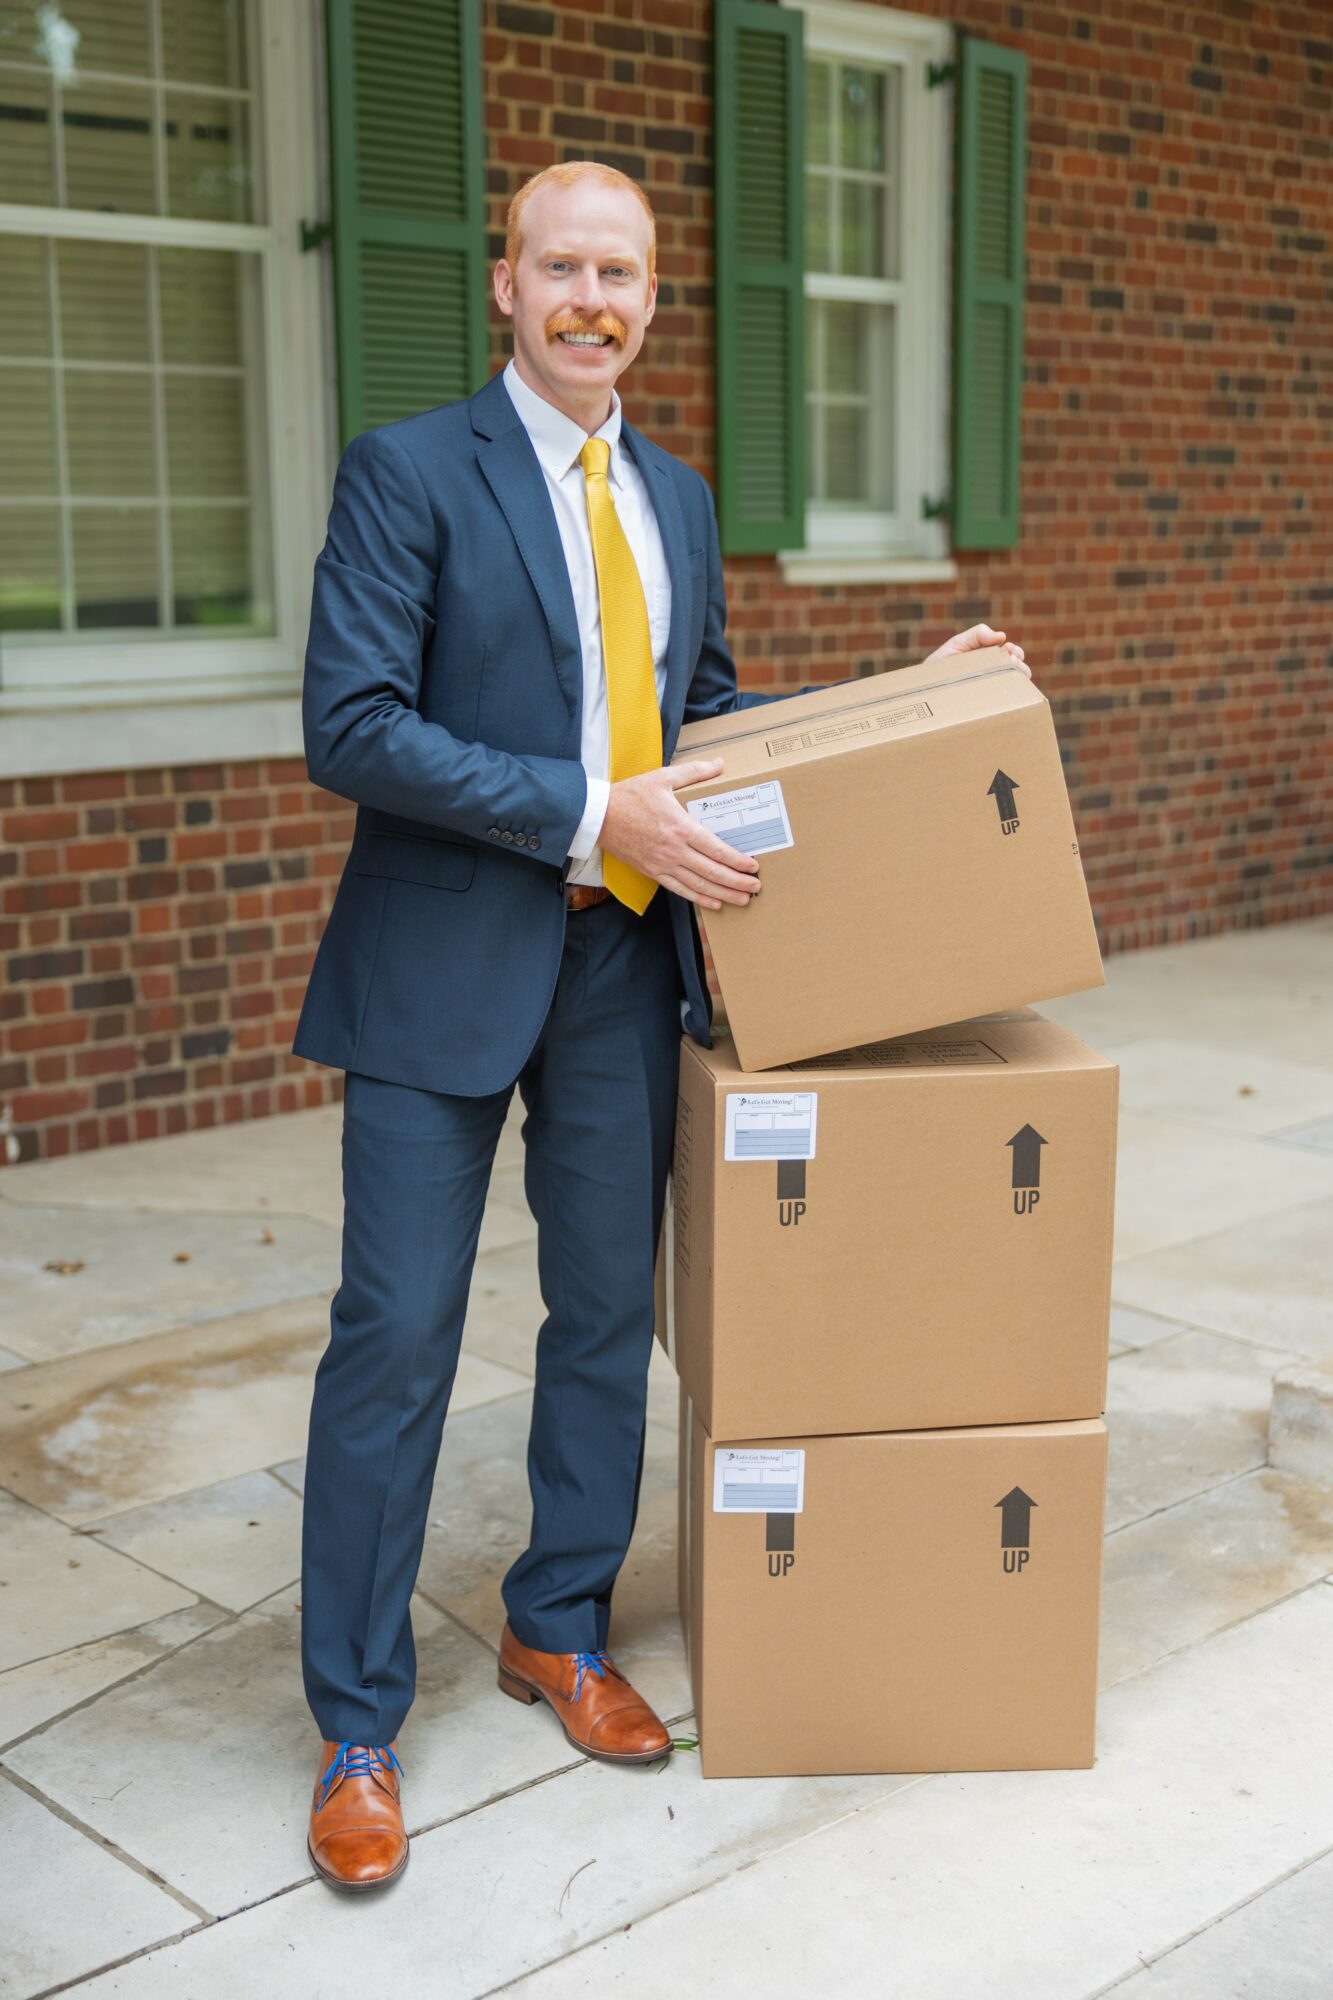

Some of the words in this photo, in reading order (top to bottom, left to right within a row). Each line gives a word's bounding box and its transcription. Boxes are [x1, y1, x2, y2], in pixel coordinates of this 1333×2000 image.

[723, 798, 733, 806] Get
[734, 792, 756, 802] Moving!
[1001, 820, 1020, 836] UP
[771, 1098, 793, 1106] Moving!
[779, 1201, 807, 1227] UP
[1013, 1190, 1040, 1215] UP
[768, 1553, 795, 1577] UP
[1003, 1550, 1030, 1574] UP
